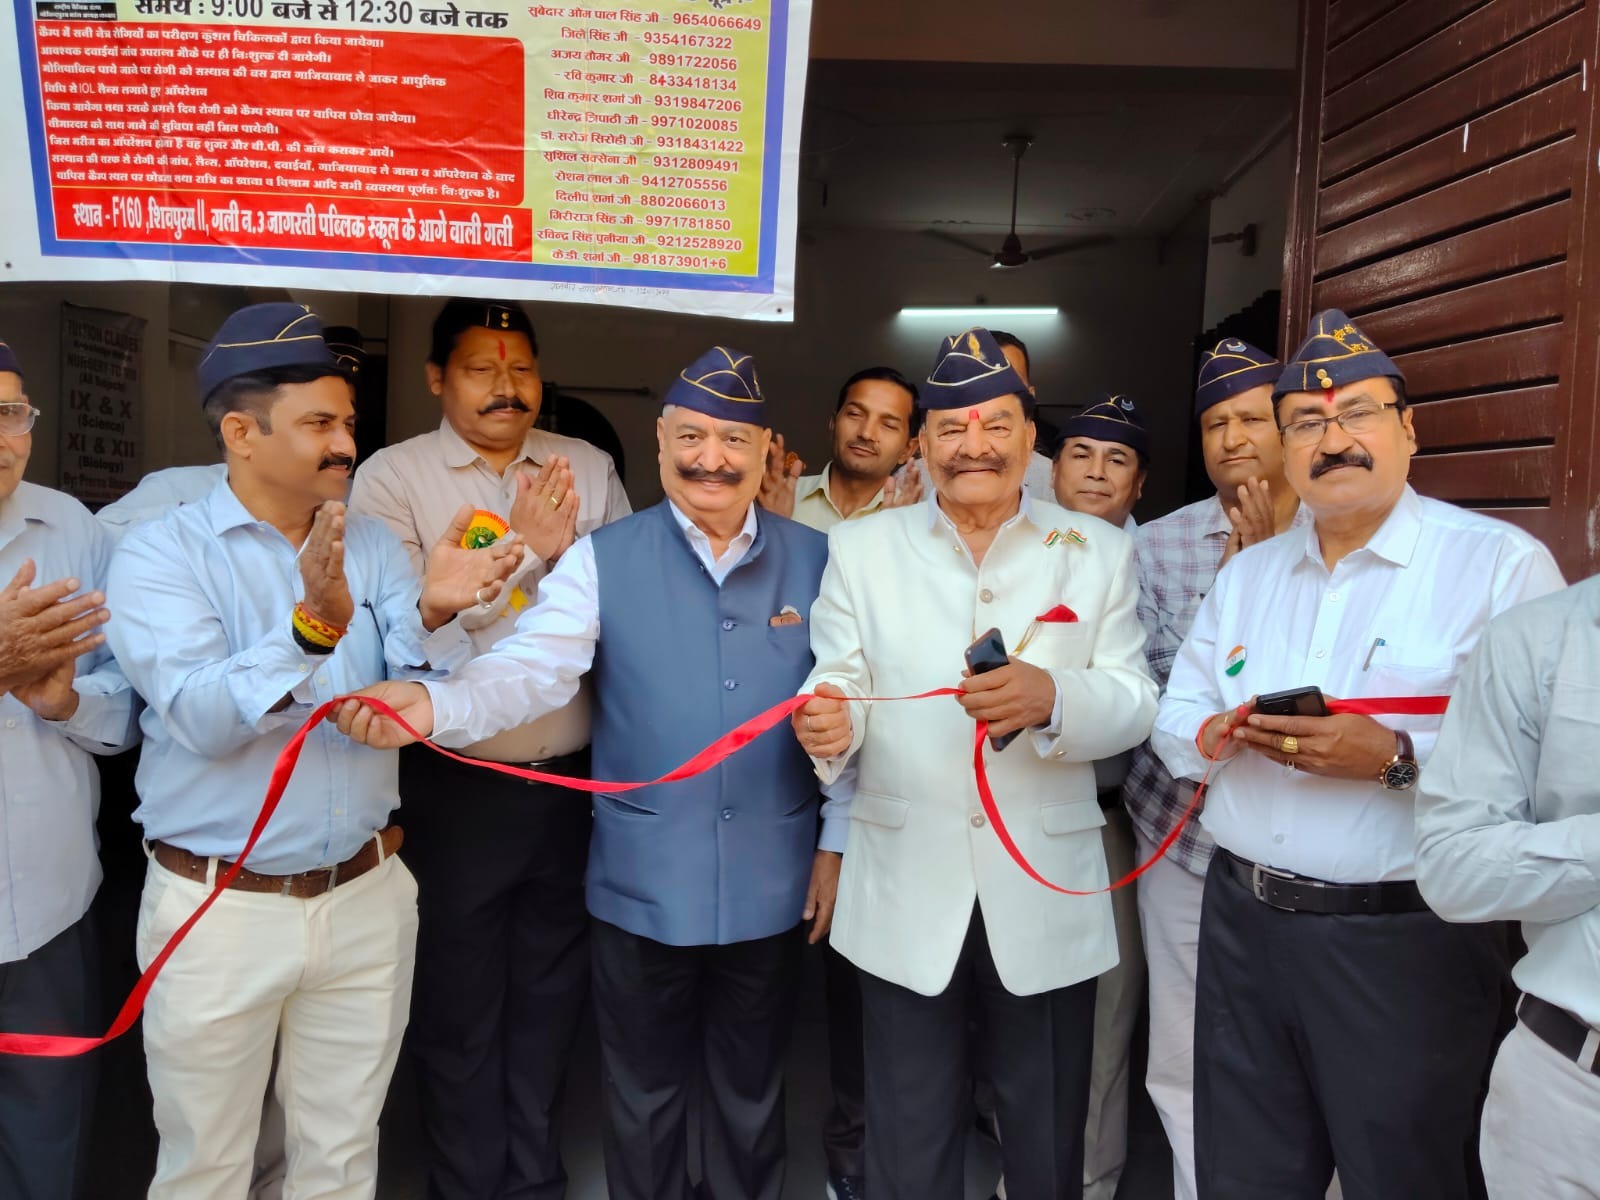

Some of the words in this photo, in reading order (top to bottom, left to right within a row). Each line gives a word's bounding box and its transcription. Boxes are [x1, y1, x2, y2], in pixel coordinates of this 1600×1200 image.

[211, 0, 263, 17] 9:00
[271, 0, 312, 19] बजे
[317, 0, 338, 20] से
[345, 0, 412, 24] 12:30
[419, 2, 459, 26] बजे
[465, 11, 508, 28] तक
[594, 11, 616, 19] पाल
[645, 12, 659, 22] जी
[672, 13, 761, 30] 9654066649
[613, 31, 627, 41] जी
[643, 32, 731, 49] 9354167322
[551, 50, 581, 59] अजय
[615, 52, 629, 62] जी
[649, 54, 736, 70] 9891722056
[564, 70, 581, 80] रवि
[584, 73, 615, 84] कुमार
[619, 73, 633, 83] जी
[79, 84, 95, 94] IOL
[544, 89, 564, 99] शिव
[567, 93, 598, 102] कुमार
[628, 94, 641, 104] जी
[654, 95, 741, 112] 9319847206
[624, 115, 638, 124] जी
[650, 115, 737, 132] 9971020085
[629, 136, 643, 145] जी
[656, 137, 744, 152] 9318431422
[622, 155, 636, 165] जी
[653, 156, 738, 171] 9312809491
[555, 171, 583, 181] रोशन
[586, 175, 612, 183] लाल
[615, 175, 629, 184] जी
[641, 176, 727, 190] 9412705556
[555, 190, 588, 201] दिलीप
[617, 194, 630, 204] जी
[640, 195, 725, 210] 8802066013
[72, 203, 103, 226] स्थान
[112, 197, 141, 228] F160
[210, 200, 239, 232] गली
[266, 203, 315, 235] जागरती
[318, 204, 365, 237] पब्लिक
[367, 216, 399, 249] स्कूल
[401, 208, 415, 240] के
[418, 210, 447, 242] आगे
[449, 213, 483, 244] वाली
[484, 215, 513, 246] गली
[619, 214, 633, 224] जी
[645, 216, 730, 230] 9971781850
[631, 235, 644, 244] जी
[657, 236, 741, 251] 9212528920
[607, 252, 620, 262] जी
[70, 389, 91, 412] IX
[99, 396, 112, 414] &
[120, 400, 132, 419] X
[68, 432, 85, 452] XI
[94, 437, 105, 454] &
[112, 438, 135, 458] XII
